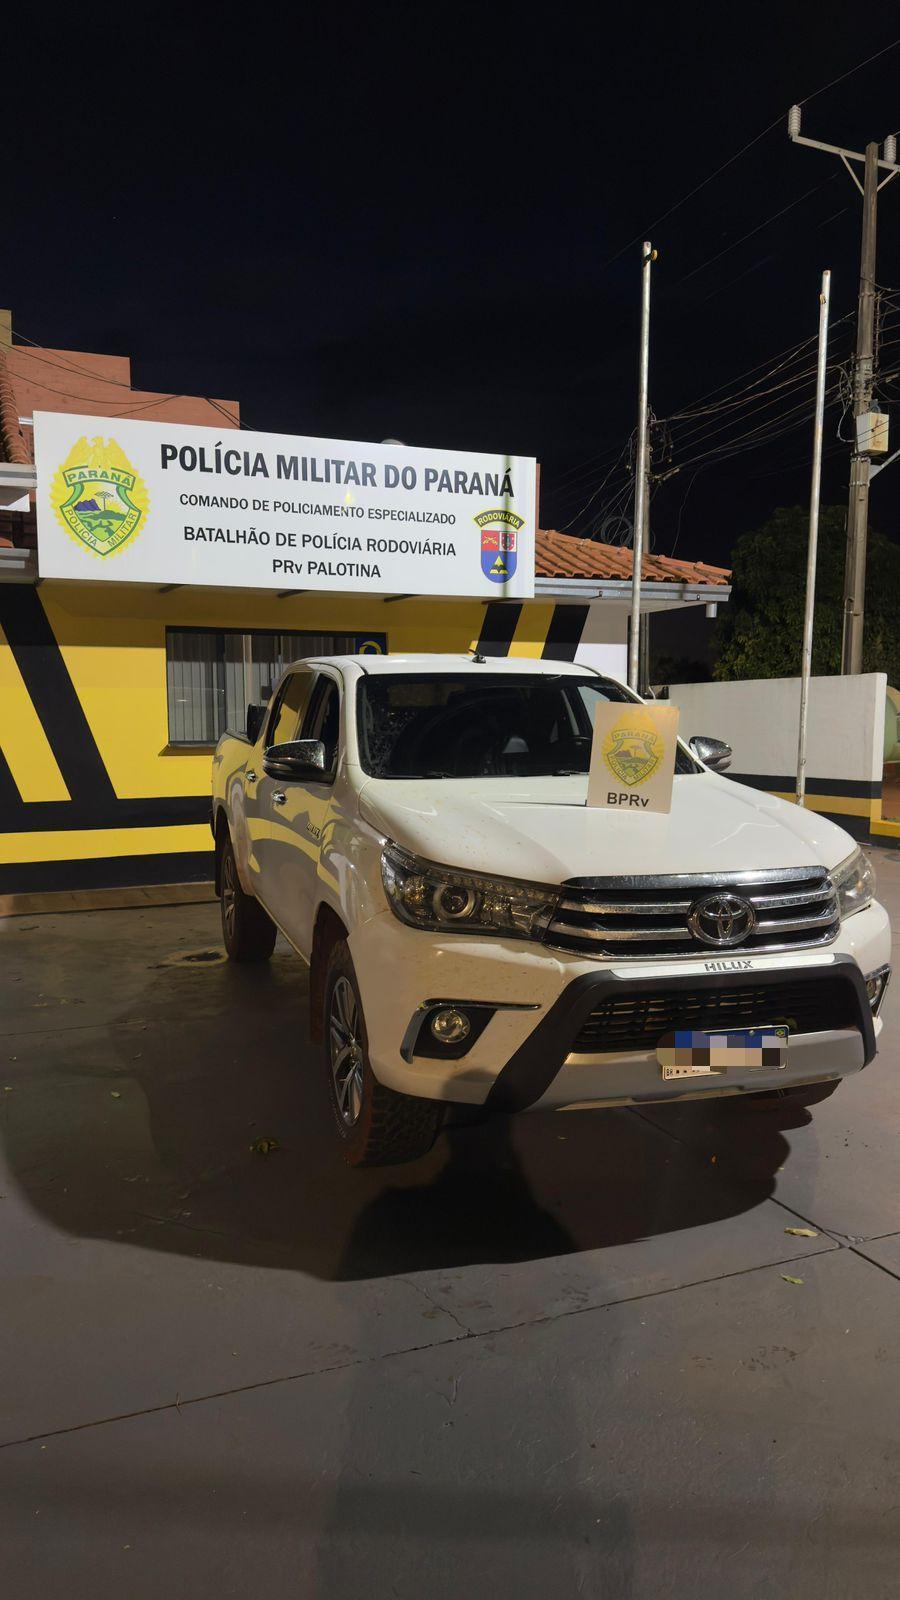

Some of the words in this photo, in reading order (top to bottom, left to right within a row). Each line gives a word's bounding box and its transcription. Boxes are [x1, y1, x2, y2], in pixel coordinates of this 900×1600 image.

[66, 469, 132, 487] PARANÁ
[161, 440, 271, 478] POLÍCIA
[276, 454, 378, 487] MILITAR
[384, 464, 418, 490] DO
[425, 467, 515, 498] PARANÁ
[179, 493, 250, 510] COMANDO
[252, 499, 270, 512] DE
[273, 500, 365, 518] POLICIAMENTO
[367, 507, 457, 525] ESPECIALIZADO
[107, 512, 137, 547] MILITAR
[477, 512, 521, 528] RODOVIÁRIA
[184, 525, 271, 545] BATALHÃO
[275, 531, 298, 547] DE
[302, 531, 363, 551] POLÍCIA
[366, 535, 456, 556] RODOVIÁRIA
[272, 558, 303, 574] PRv
[307, 561, 381, 579] PALOTINA
[606, 791, 650, 808] BPRv
[704, 960, 754, 972] HILUX
